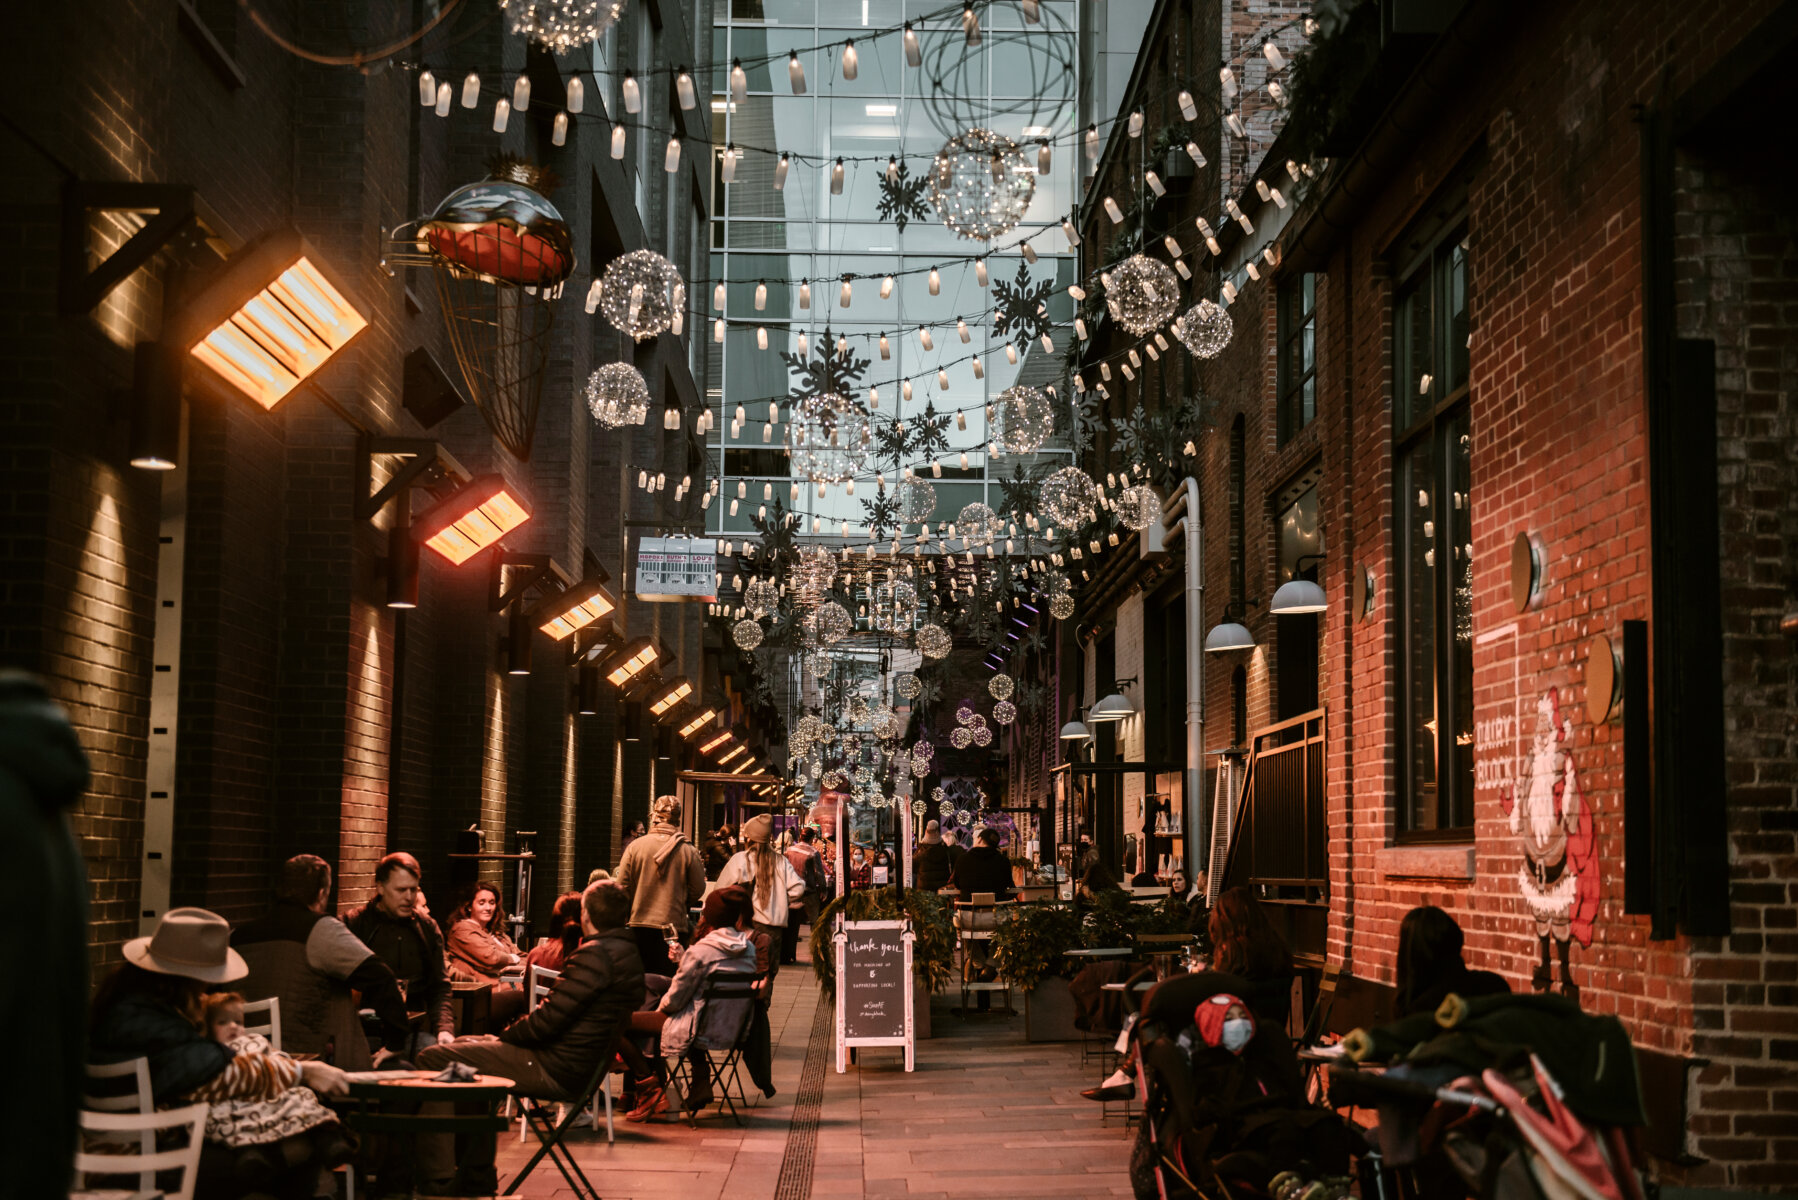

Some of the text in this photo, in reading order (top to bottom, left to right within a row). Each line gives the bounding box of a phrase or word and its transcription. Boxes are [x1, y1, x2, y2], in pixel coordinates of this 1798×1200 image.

[1476, 714, 1512, 752] DAIRY
[1476, 756, 1514, 791] BLOCK
[850, 938, 903, 957] thank you
